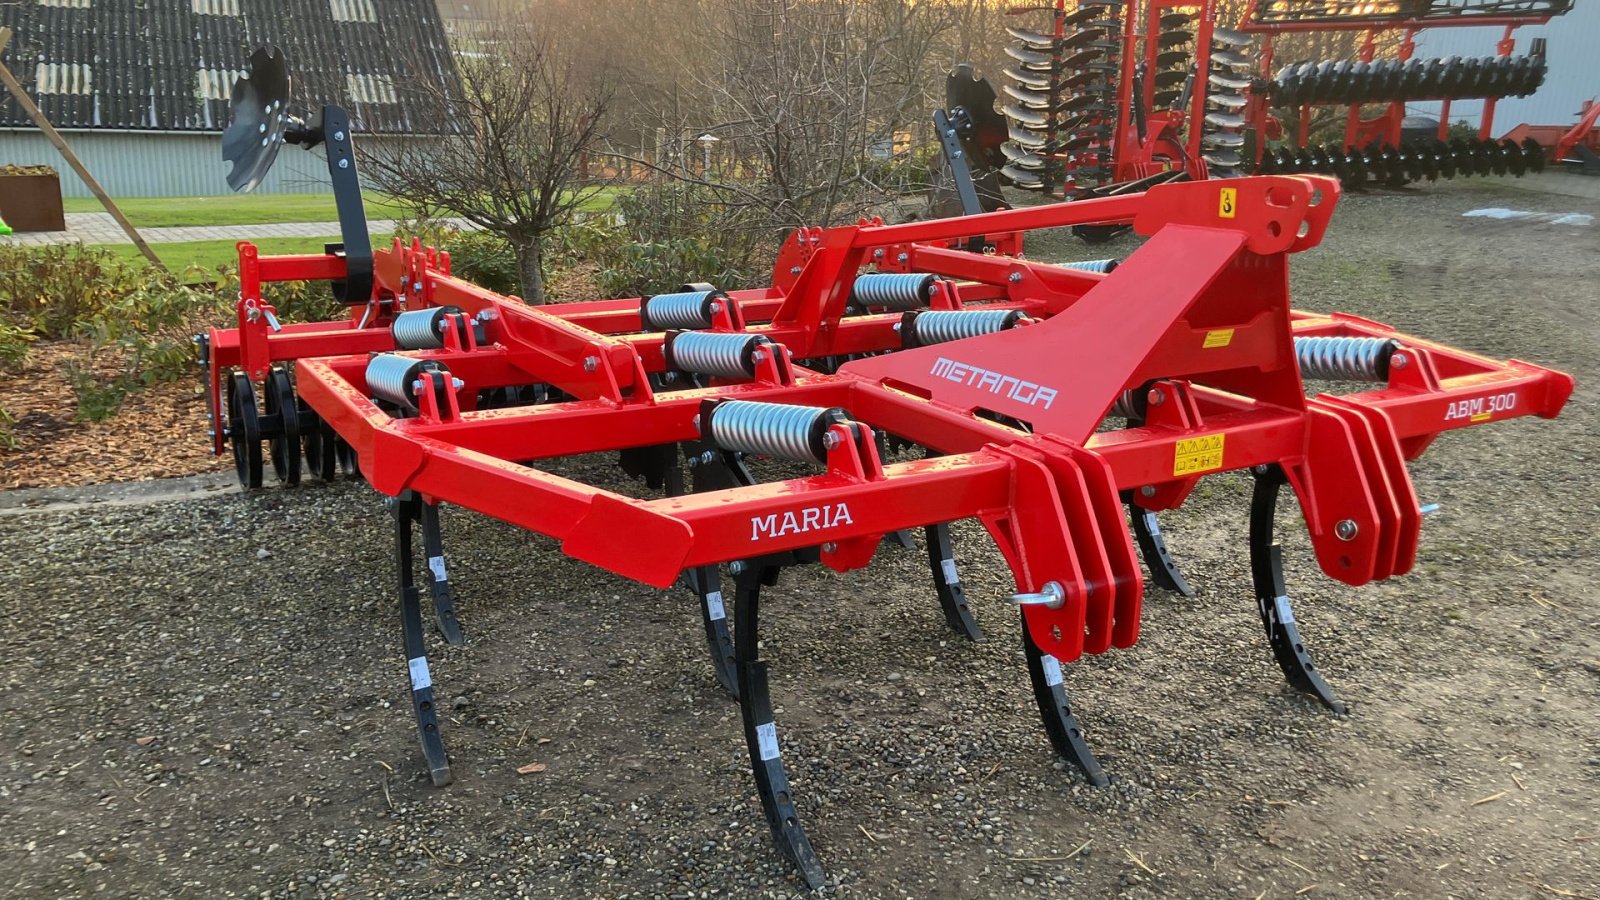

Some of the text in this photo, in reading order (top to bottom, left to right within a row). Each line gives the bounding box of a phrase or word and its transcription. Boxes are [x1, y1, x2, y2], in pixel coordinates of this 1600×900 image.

[930, 357, 1058, 410] METANGA
[1444, 392, 1516, 420] ABM 300
[751, 502, 853, 540] MARIA
